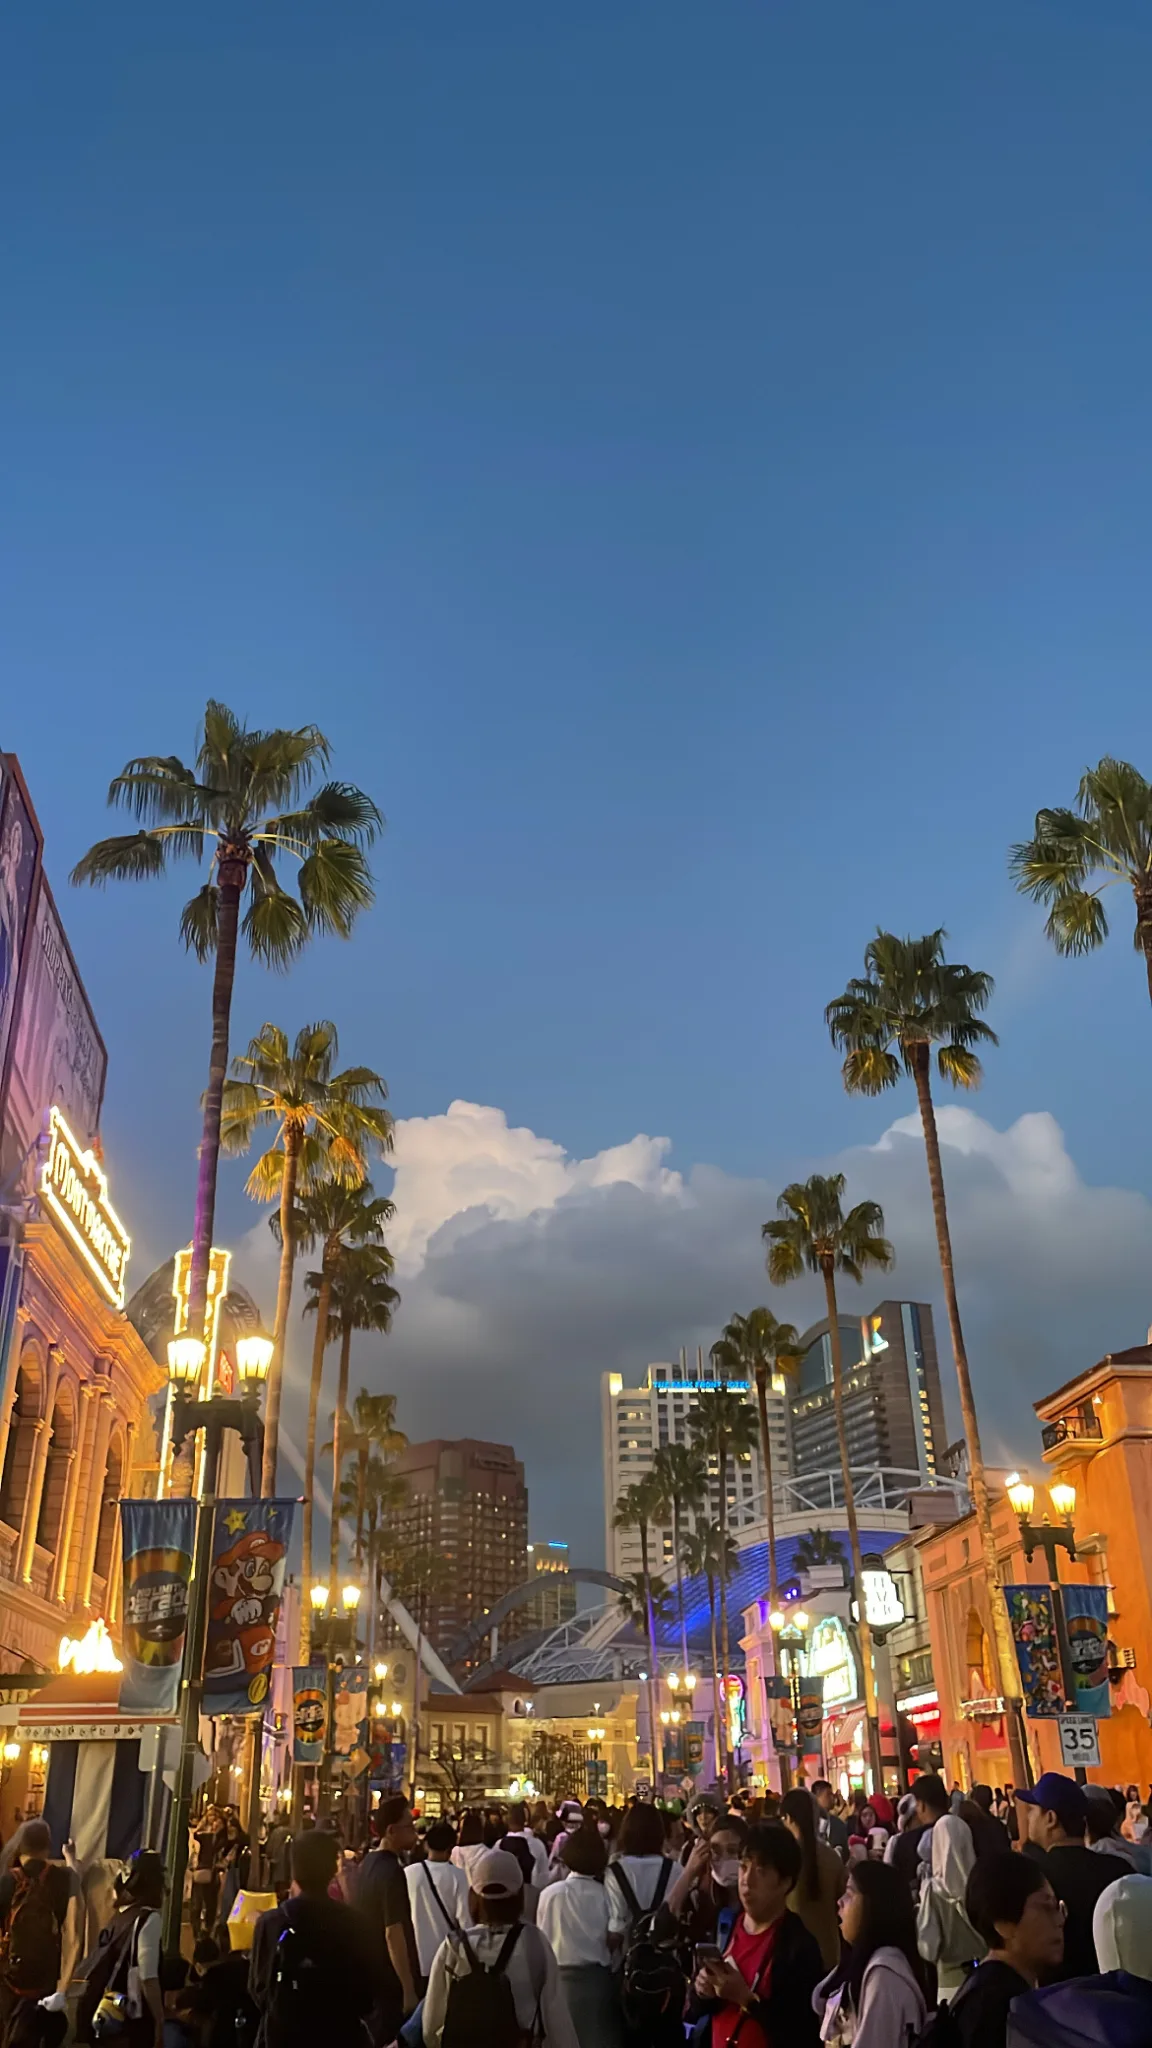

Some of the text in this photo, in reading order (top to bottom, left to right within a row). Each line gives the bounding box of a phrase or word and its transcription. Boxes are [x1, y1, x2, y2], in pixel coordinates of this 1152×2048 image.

[653, 1380, 669, 1389] THE
[671, 1380, 693, 1389] PARK
[695, 1380, 721, 1389] FRONT
[1063, 1728, 1095, 1750] 35
